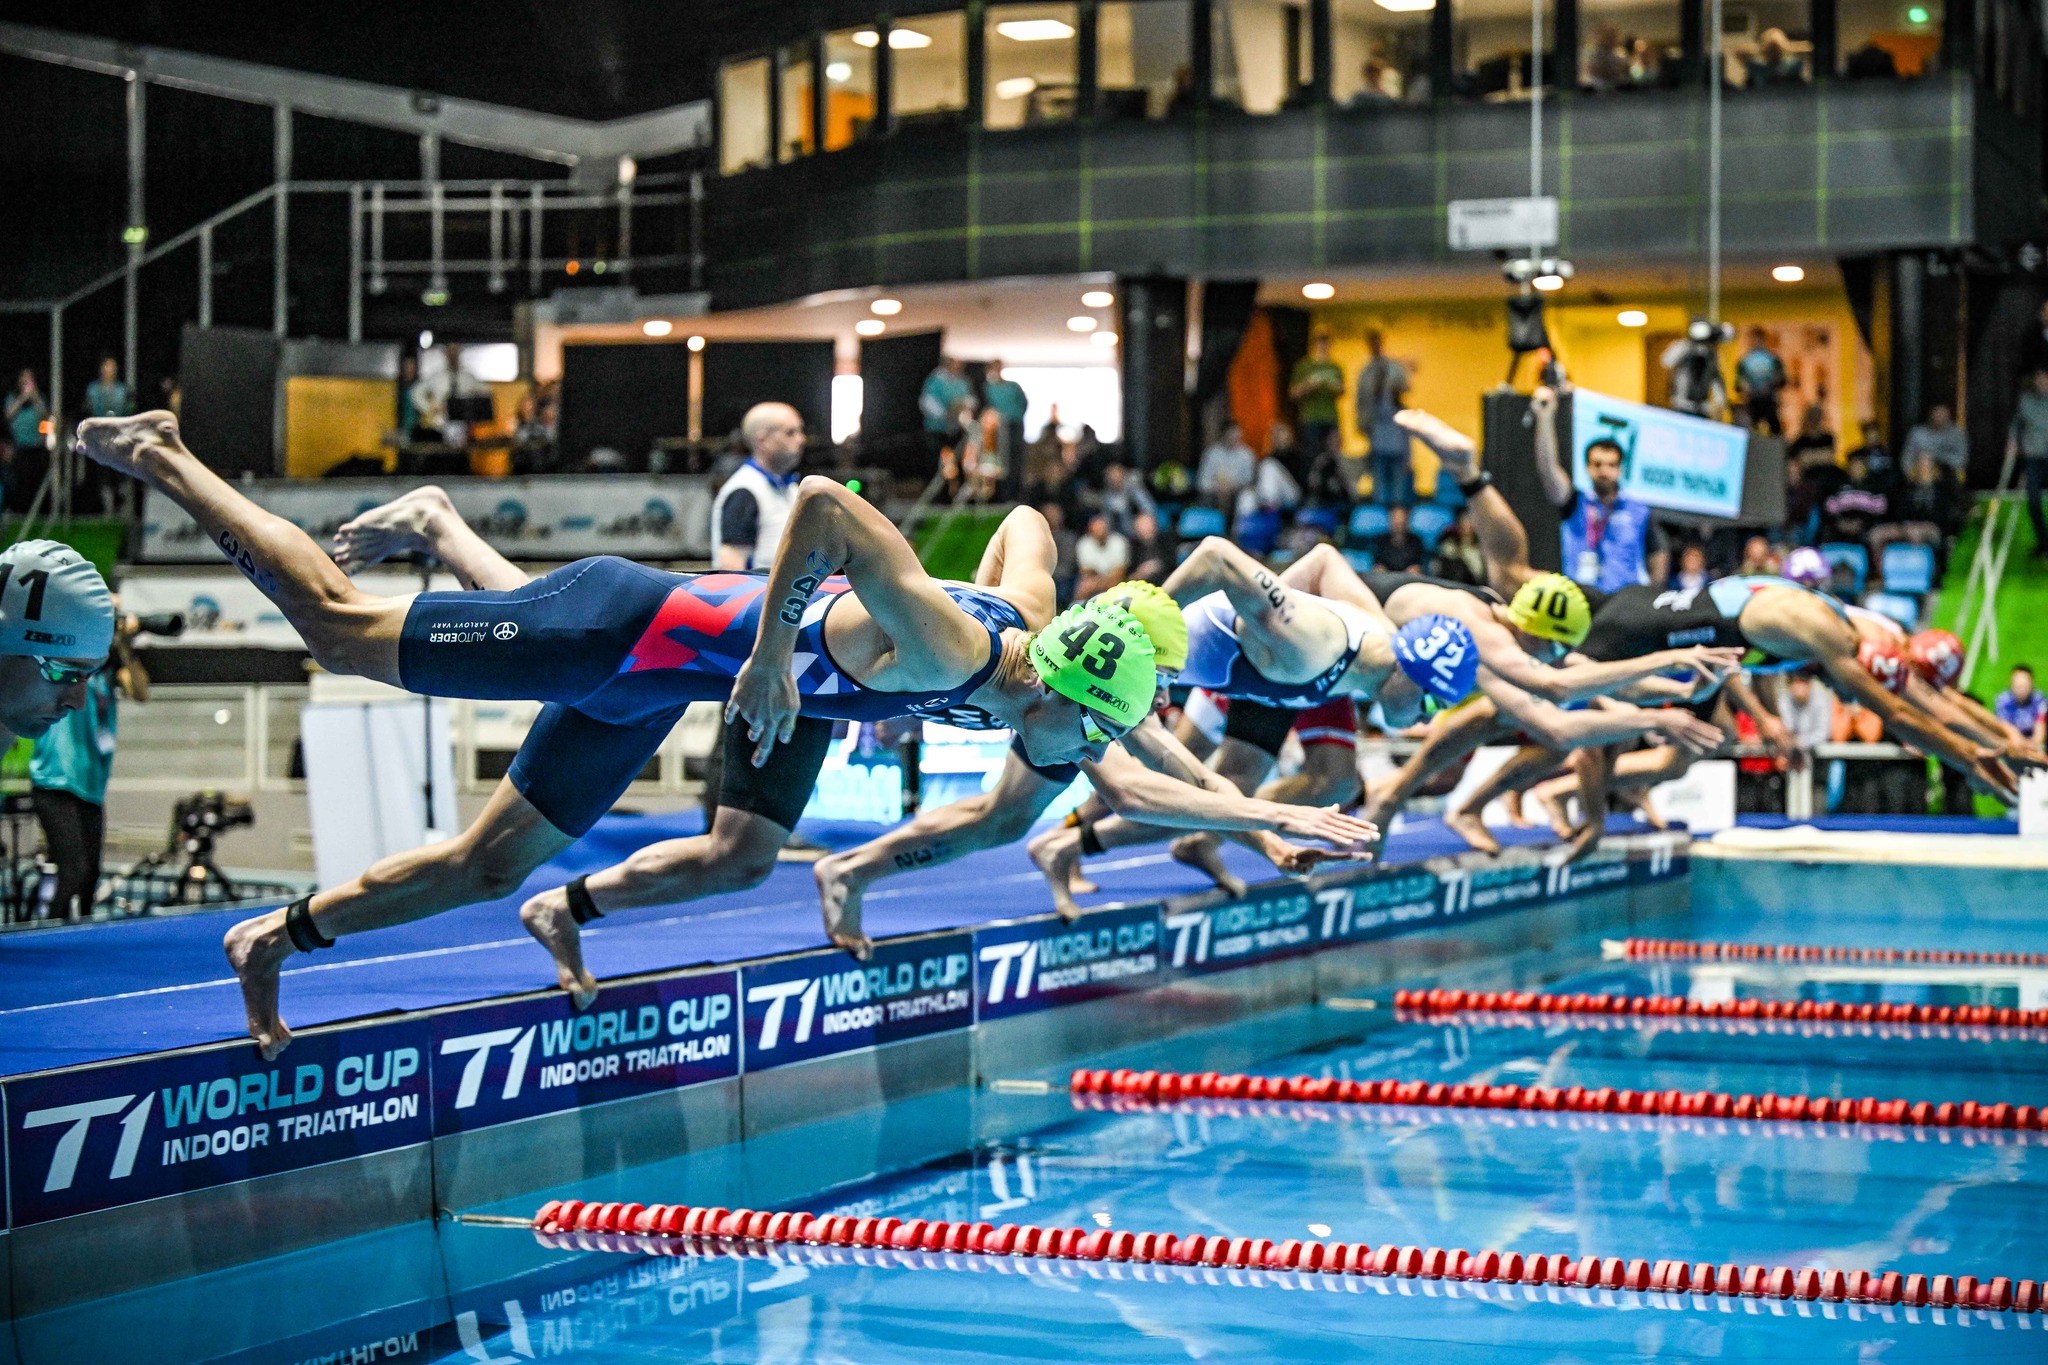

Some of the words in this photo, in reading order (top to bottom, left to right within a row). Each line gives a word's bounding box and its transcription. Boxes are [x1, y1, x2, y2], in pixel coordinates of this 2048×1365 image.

[779, 574, 821, 627] 43
[1532, 587, 1568, 619] 10
[429, 631, 487, 643] AUTOEDER
[1058, 619, 1126, 681] 43
[1413, 626, 1465, 681] 32
[1039, 928, 1113, 968] WORLD
[1116, 921, 1157, 954] CUP
[1165, 911, 1211, 968] T1
[822, 962, 914, 1008] WORLD
[919, 953, 969, 990] CUP
[979, 940, 1039, 1004] T1
[540, 1005, 661, 1057] WORLD
[667, 993, 732, 1036] CUP
[747, 977, 821, 1051] T1
[823, 1004, 884, 1036] INDOOR
[887, 988, 970, 1022] TRIATHLON
[161, 1063, 325, 1129] WORLD
[335, 1046, 420, 1097] CUP
[440, 1025, 537, 1110] T1
[540, 1058, 620, 1090] INDOOR
[625, 1034, 731, 1073] TRIATHLON
[22, 1091, 155, 1193] T1
[161, 1122, 270, 1166] INDOOR
[277, 1093, 419, 1142] TRIATHLON
